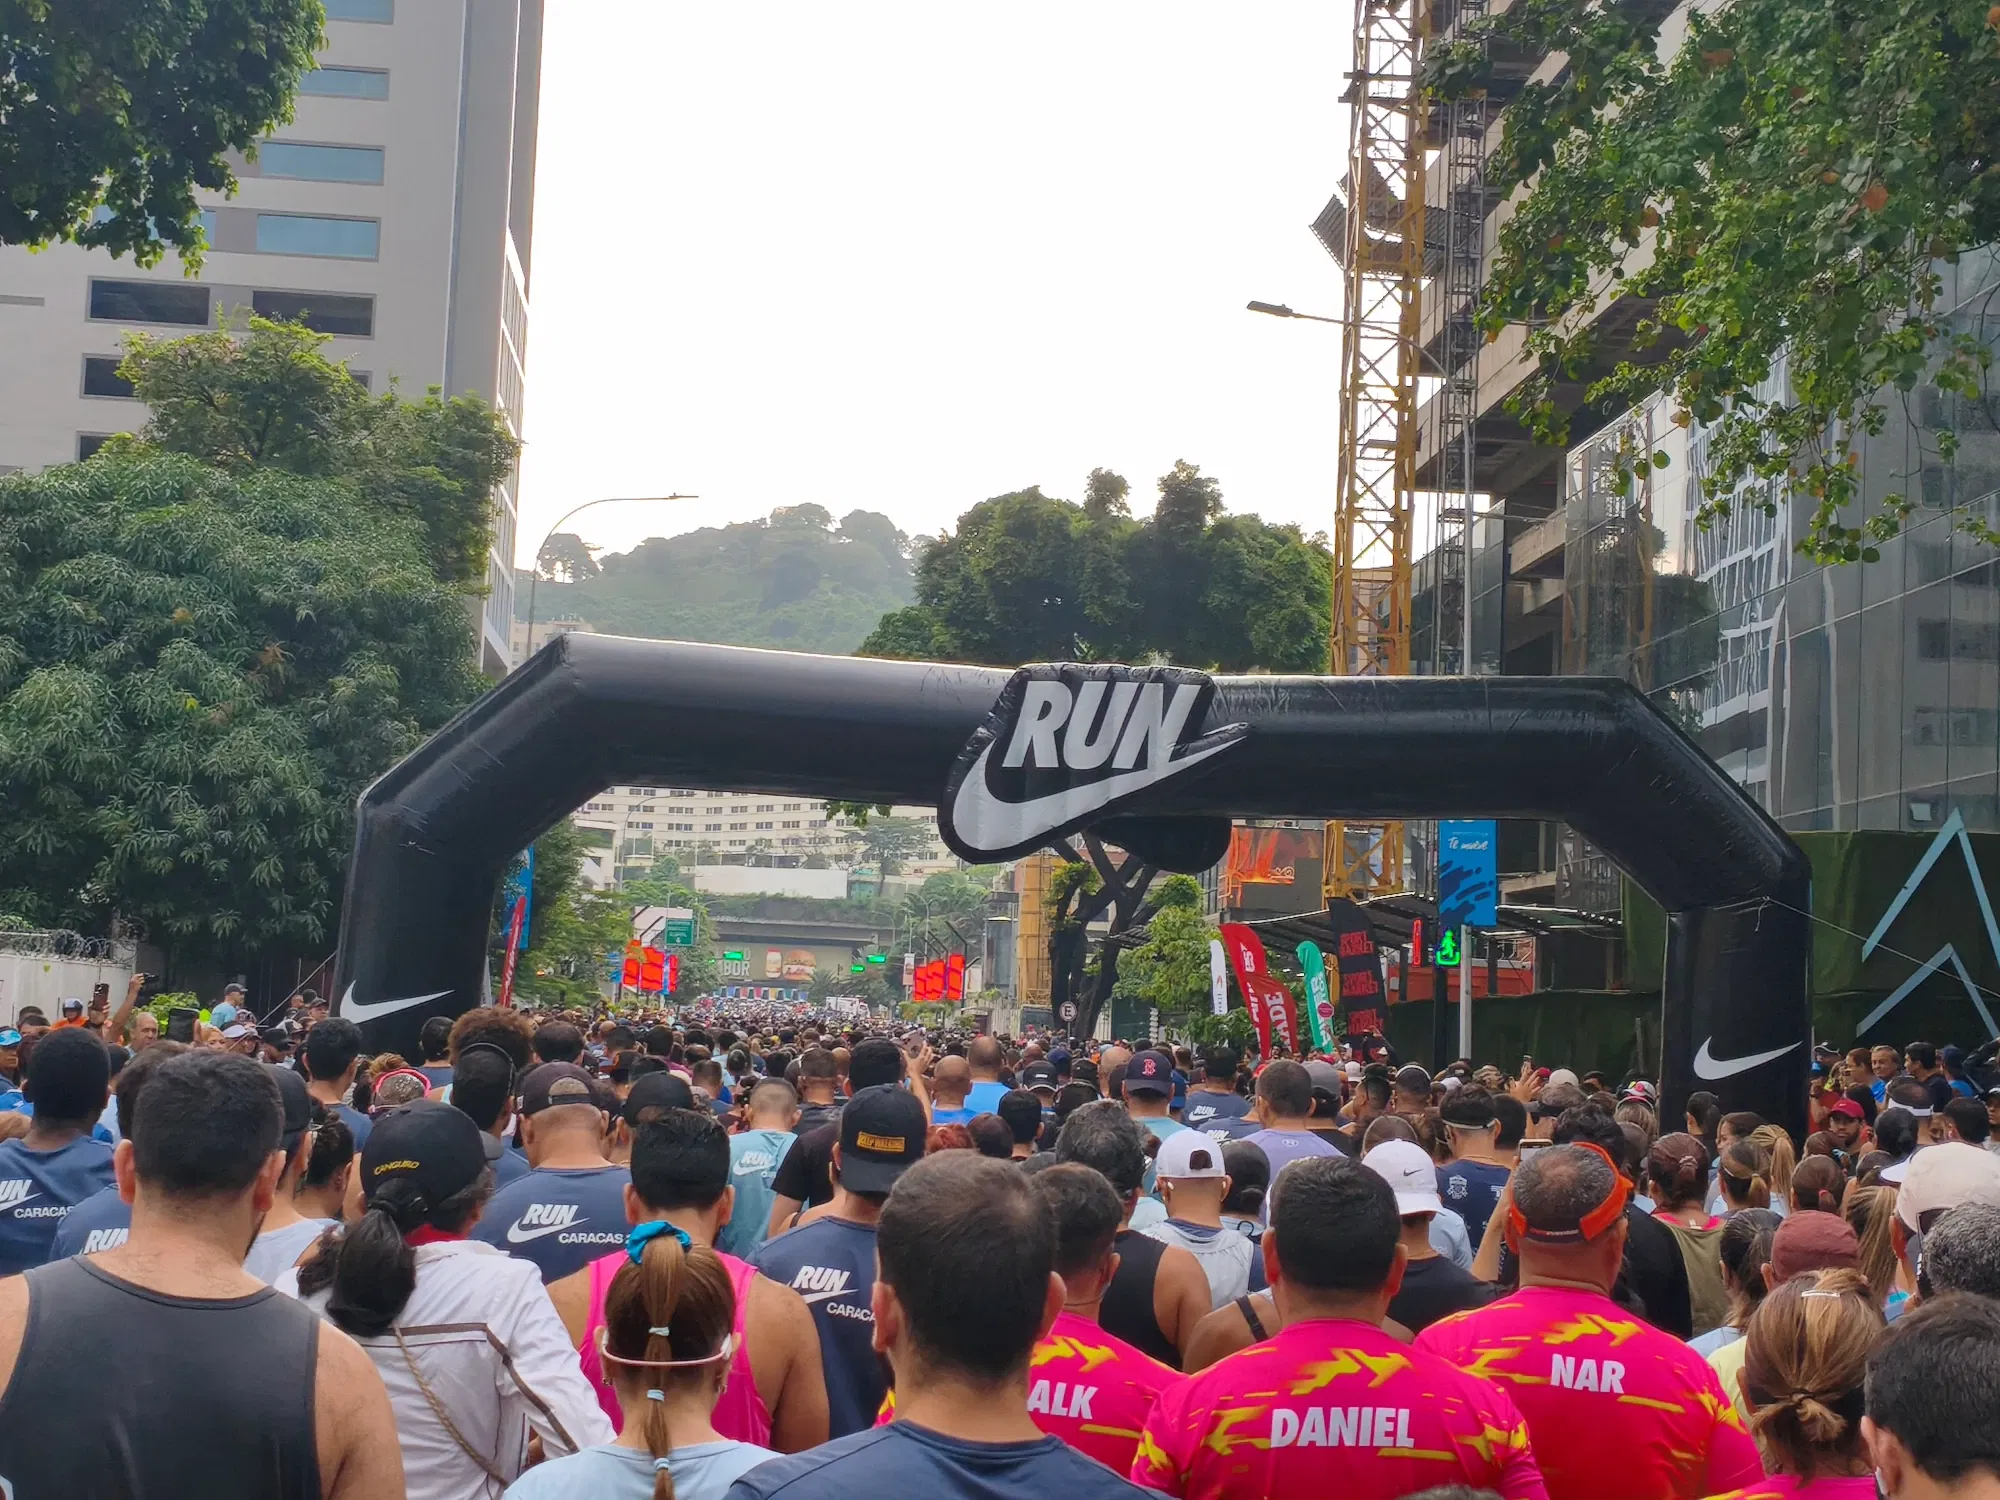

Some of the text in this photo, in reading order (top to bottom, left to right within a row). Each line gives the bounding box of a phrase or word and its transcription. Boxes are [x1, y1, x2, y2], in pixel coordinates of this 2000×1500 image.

[1002, 681, 1202, 770] RUN
[1064, 1005, 1072, 1017] E
[1193, 1105, 1217, 1116] RUN
[740, 1150, 777, 1166] RUN
[0, 1179, 33, 1201] UN
[522, 1203, 579, 1226] RUN
[558, 1232, 623, 1244] CARACAS
[792, 1265, 851, 1292] RUN
[826, 1302, 876, 1322] CARACA
[1551, 1354, 1625, 1394] NAR
[1027, 1379, 1099, 1420] ALK
[1270, 1408, 1415, 1448] DANIEL
